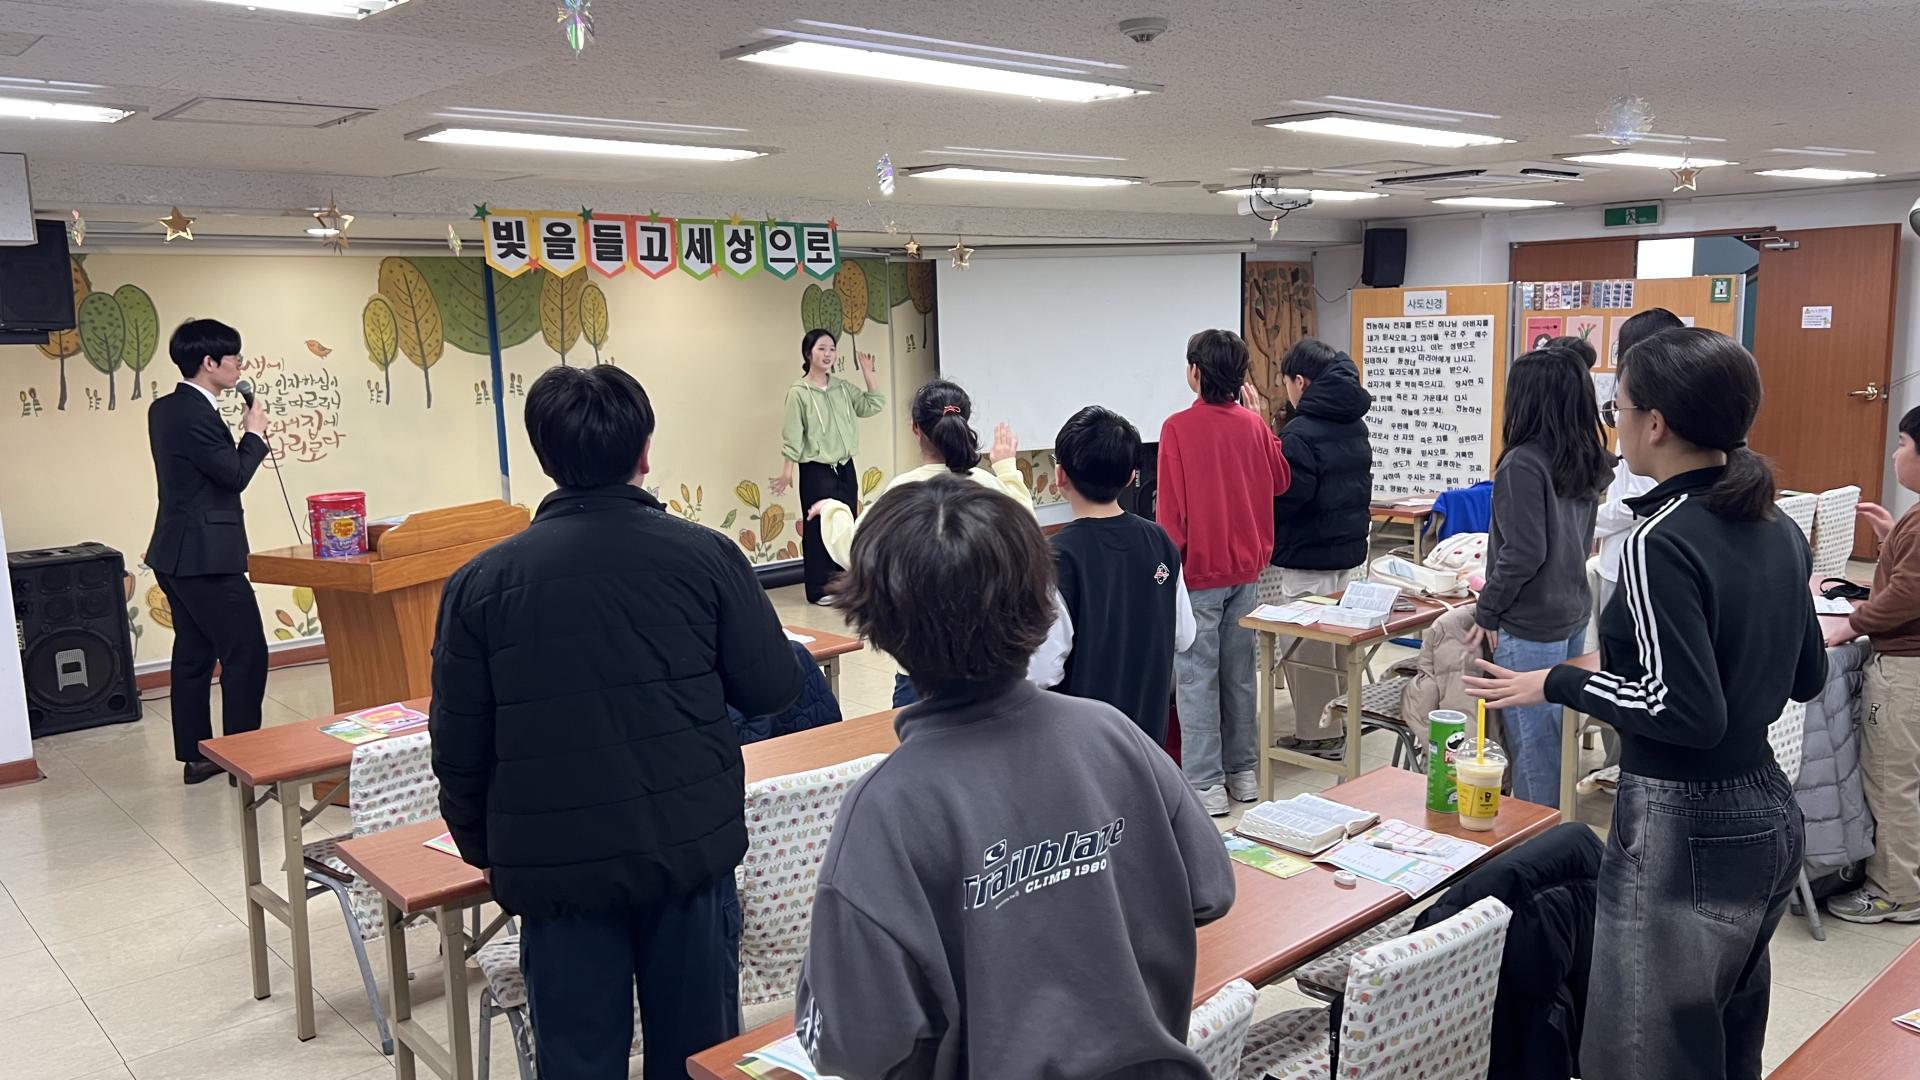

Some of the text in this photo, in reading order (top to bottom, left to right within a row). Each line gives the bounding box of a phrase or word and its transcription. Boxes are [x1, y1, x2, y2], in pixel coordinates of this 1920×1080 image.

[1407, 298, 1443, 310] 사도신경
[1438, 320, 1457, 328] 하나님
[1462, 319, 1489, 328] 아버지를
[1444, 330, 1457, 338] 우리
[1460, 330, 1466, 338] 주
[1365, 345, 1395, 354] 그리스도를
[1430, 343, 1443, 351] 이는
[275, 368, 338, 396] 인자하심이
[1454, 394, 1468, 402] 다시
[1025, 858, 1107, 894] CLIMB 1980
